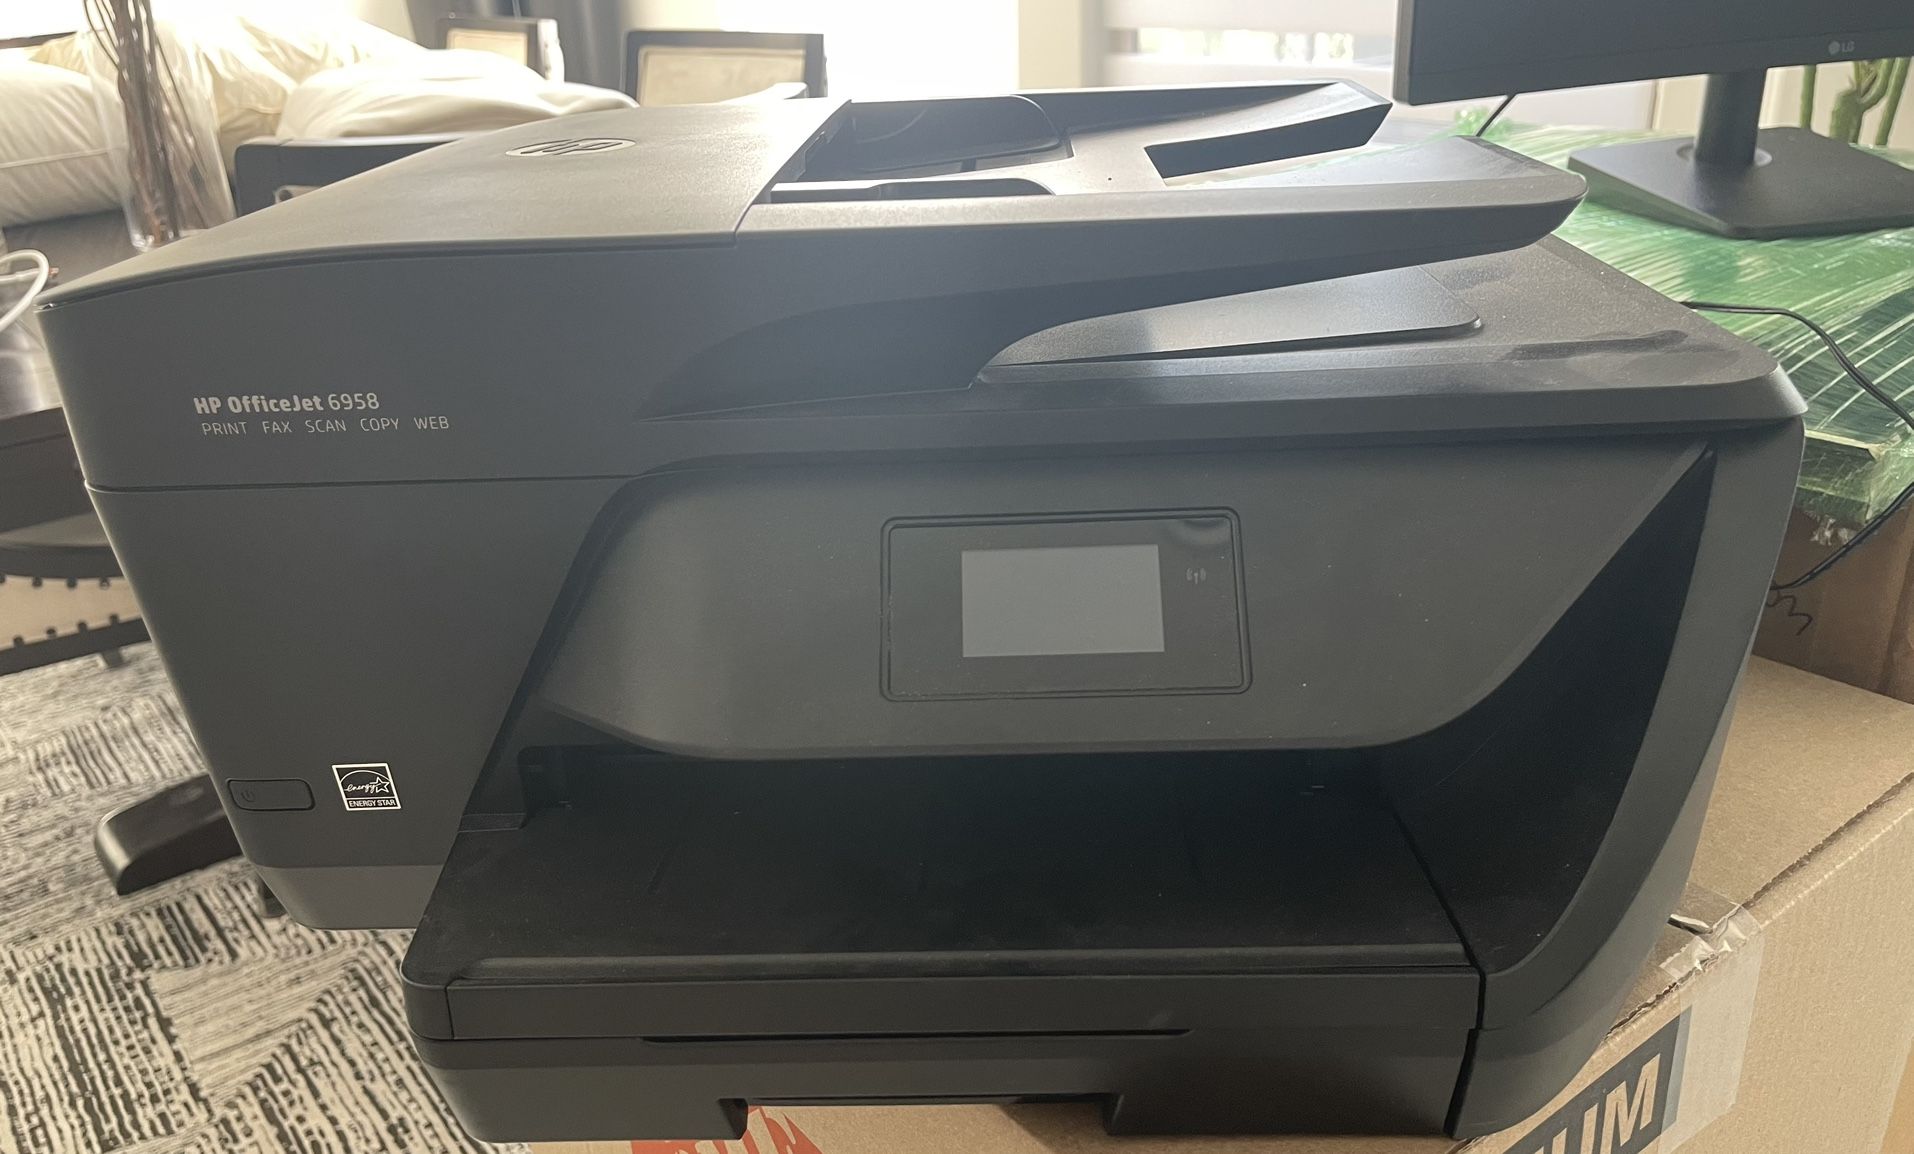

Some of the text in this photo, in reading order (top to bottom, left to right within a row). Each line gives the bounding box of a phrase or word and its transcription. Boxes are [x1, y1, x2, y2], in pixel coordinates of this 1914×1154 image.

[1841, 40, 1855, 52] LG
[194, 392, 380, 414] HP OfficeJet 6958
[201, 416, 449, 435] PRINT FAX SCAN COPY WEB
[348, 799, 396, 808] ENERGY STAR
